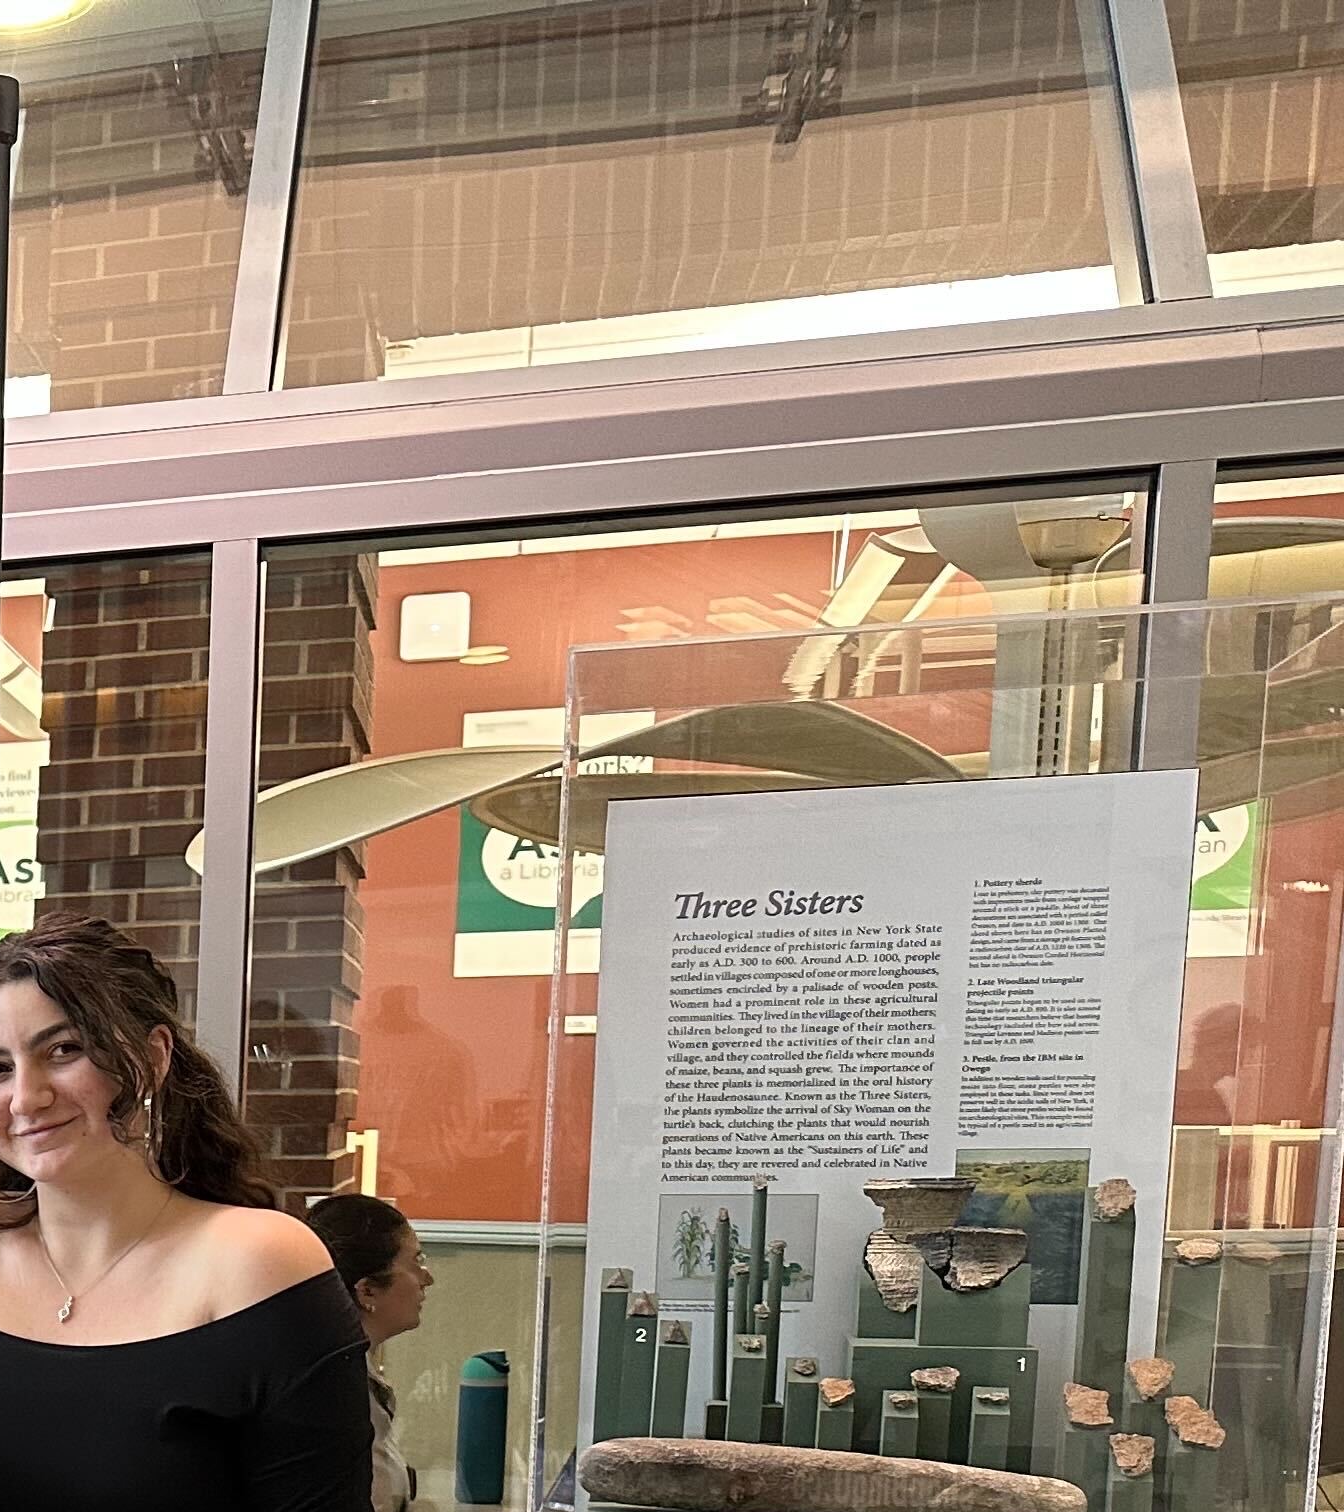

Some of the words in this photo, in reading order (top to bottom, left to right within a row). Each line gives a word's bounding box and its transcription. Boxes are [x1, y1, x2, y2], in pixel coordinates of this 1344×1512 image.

[500, 869, 511, 879] a
[675, 891, 757, 919] Three
[764, 890, 865, 916] Sisters
[673, 929, 753, 943] Archaeological
[798, 927, 811, 937] of
[813, 926, 838, 937] sites
[841, 926, 852, 936] in
[856, 925, 882, 936] New
[886, 924, 911, 935] York
[915, 923, 942, 934] State
[672, 943, 722, 956] produced
[724, 942, 771, 953] evidence
[774, 942, 787, 952] of
[788, 940, 847, 953] prehistoric
[849, 938, 894, 952] farming
[896, 938, 927, 948] dated
[671, 957, 696, 970] early
[762, 956, 772, 966] to
[800, 954, 842, 965] Around
[904, 951, 941, 964] people
[635, 1329, 647, 1342] 2
[1017, 1357, 1026, 1371] 1
